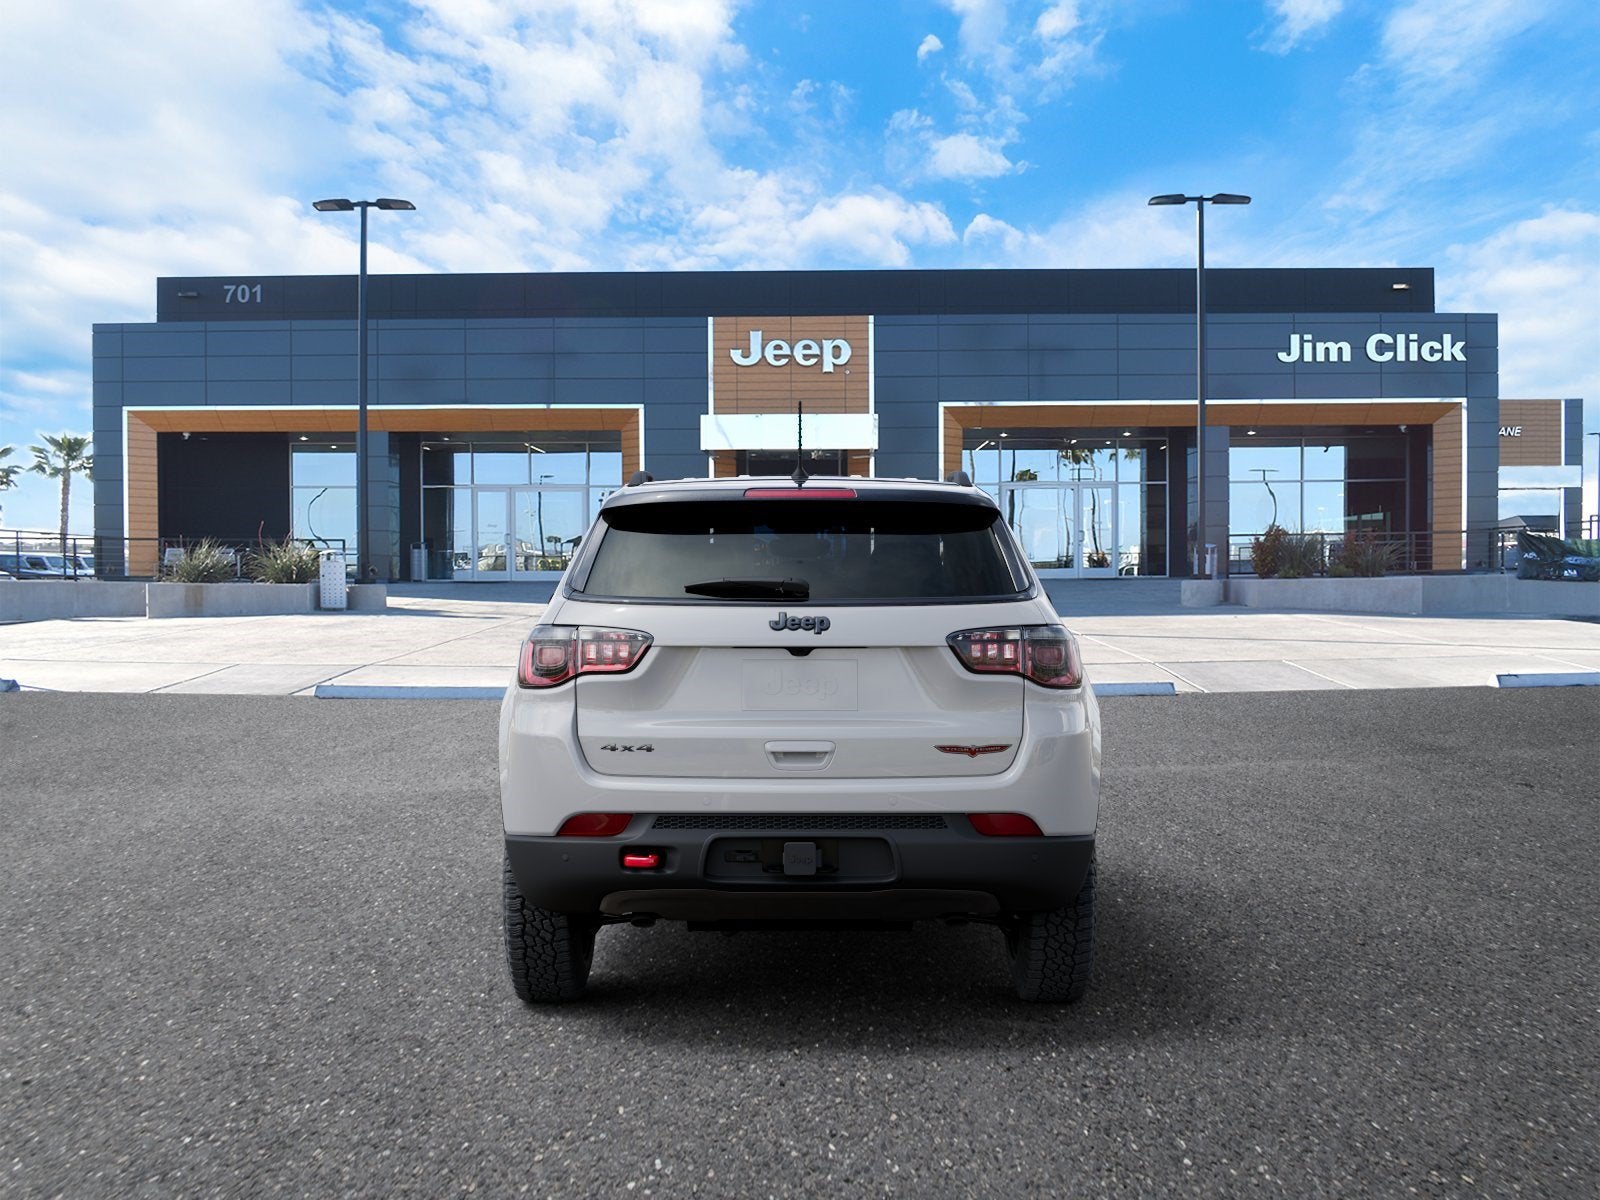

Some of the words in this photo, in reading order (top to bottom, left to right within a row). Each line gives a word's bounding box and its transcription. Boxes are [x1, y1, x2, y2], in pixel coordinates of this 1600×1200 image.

[223, 284, 262, 304] 701
[729, 330, 852, 374] Jeep
[1277, 333, 1352, 363] Jim
[1365, 333, 1467, 363] Click
[769, 611, 831, 635] Jeep
[765, 665, 840, 702] Jeep
